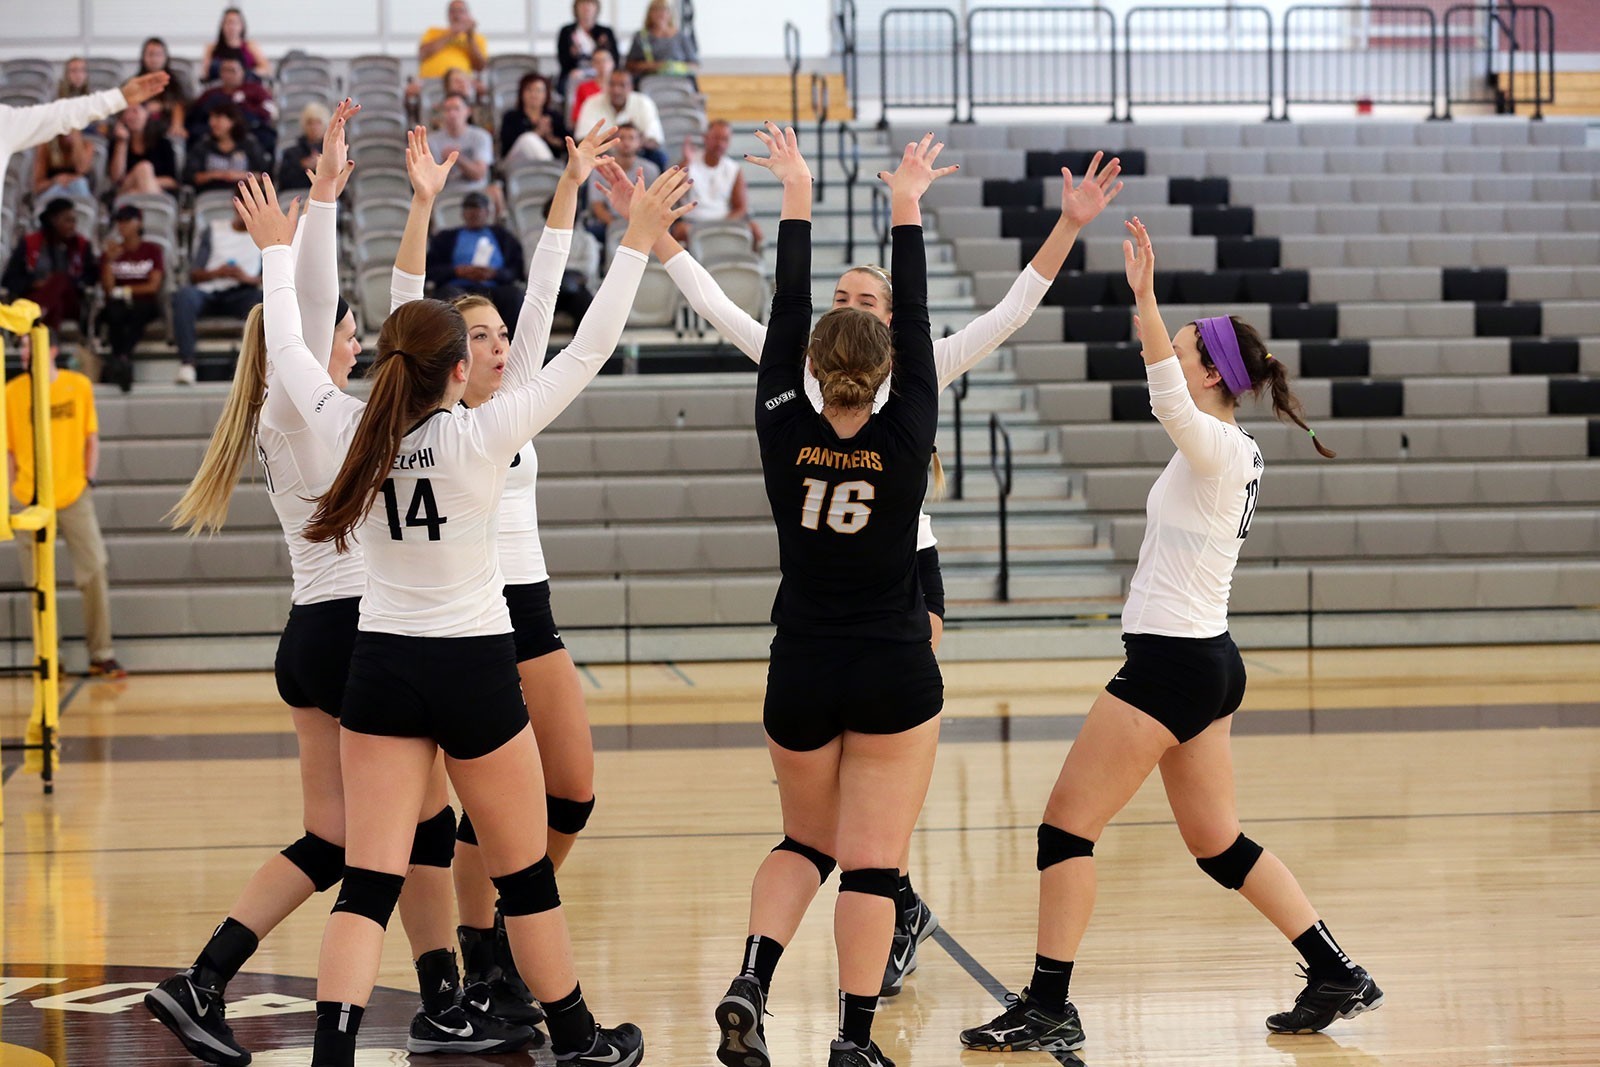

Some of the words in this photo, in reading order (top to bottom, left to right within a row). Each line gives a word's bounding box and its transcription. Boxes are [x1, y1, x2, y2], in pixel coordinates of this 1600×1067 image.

[796, 447, 883, 471] PANTHERS
[378, 478, 447, 541] 14
[801, 477, 875, 534] 16
